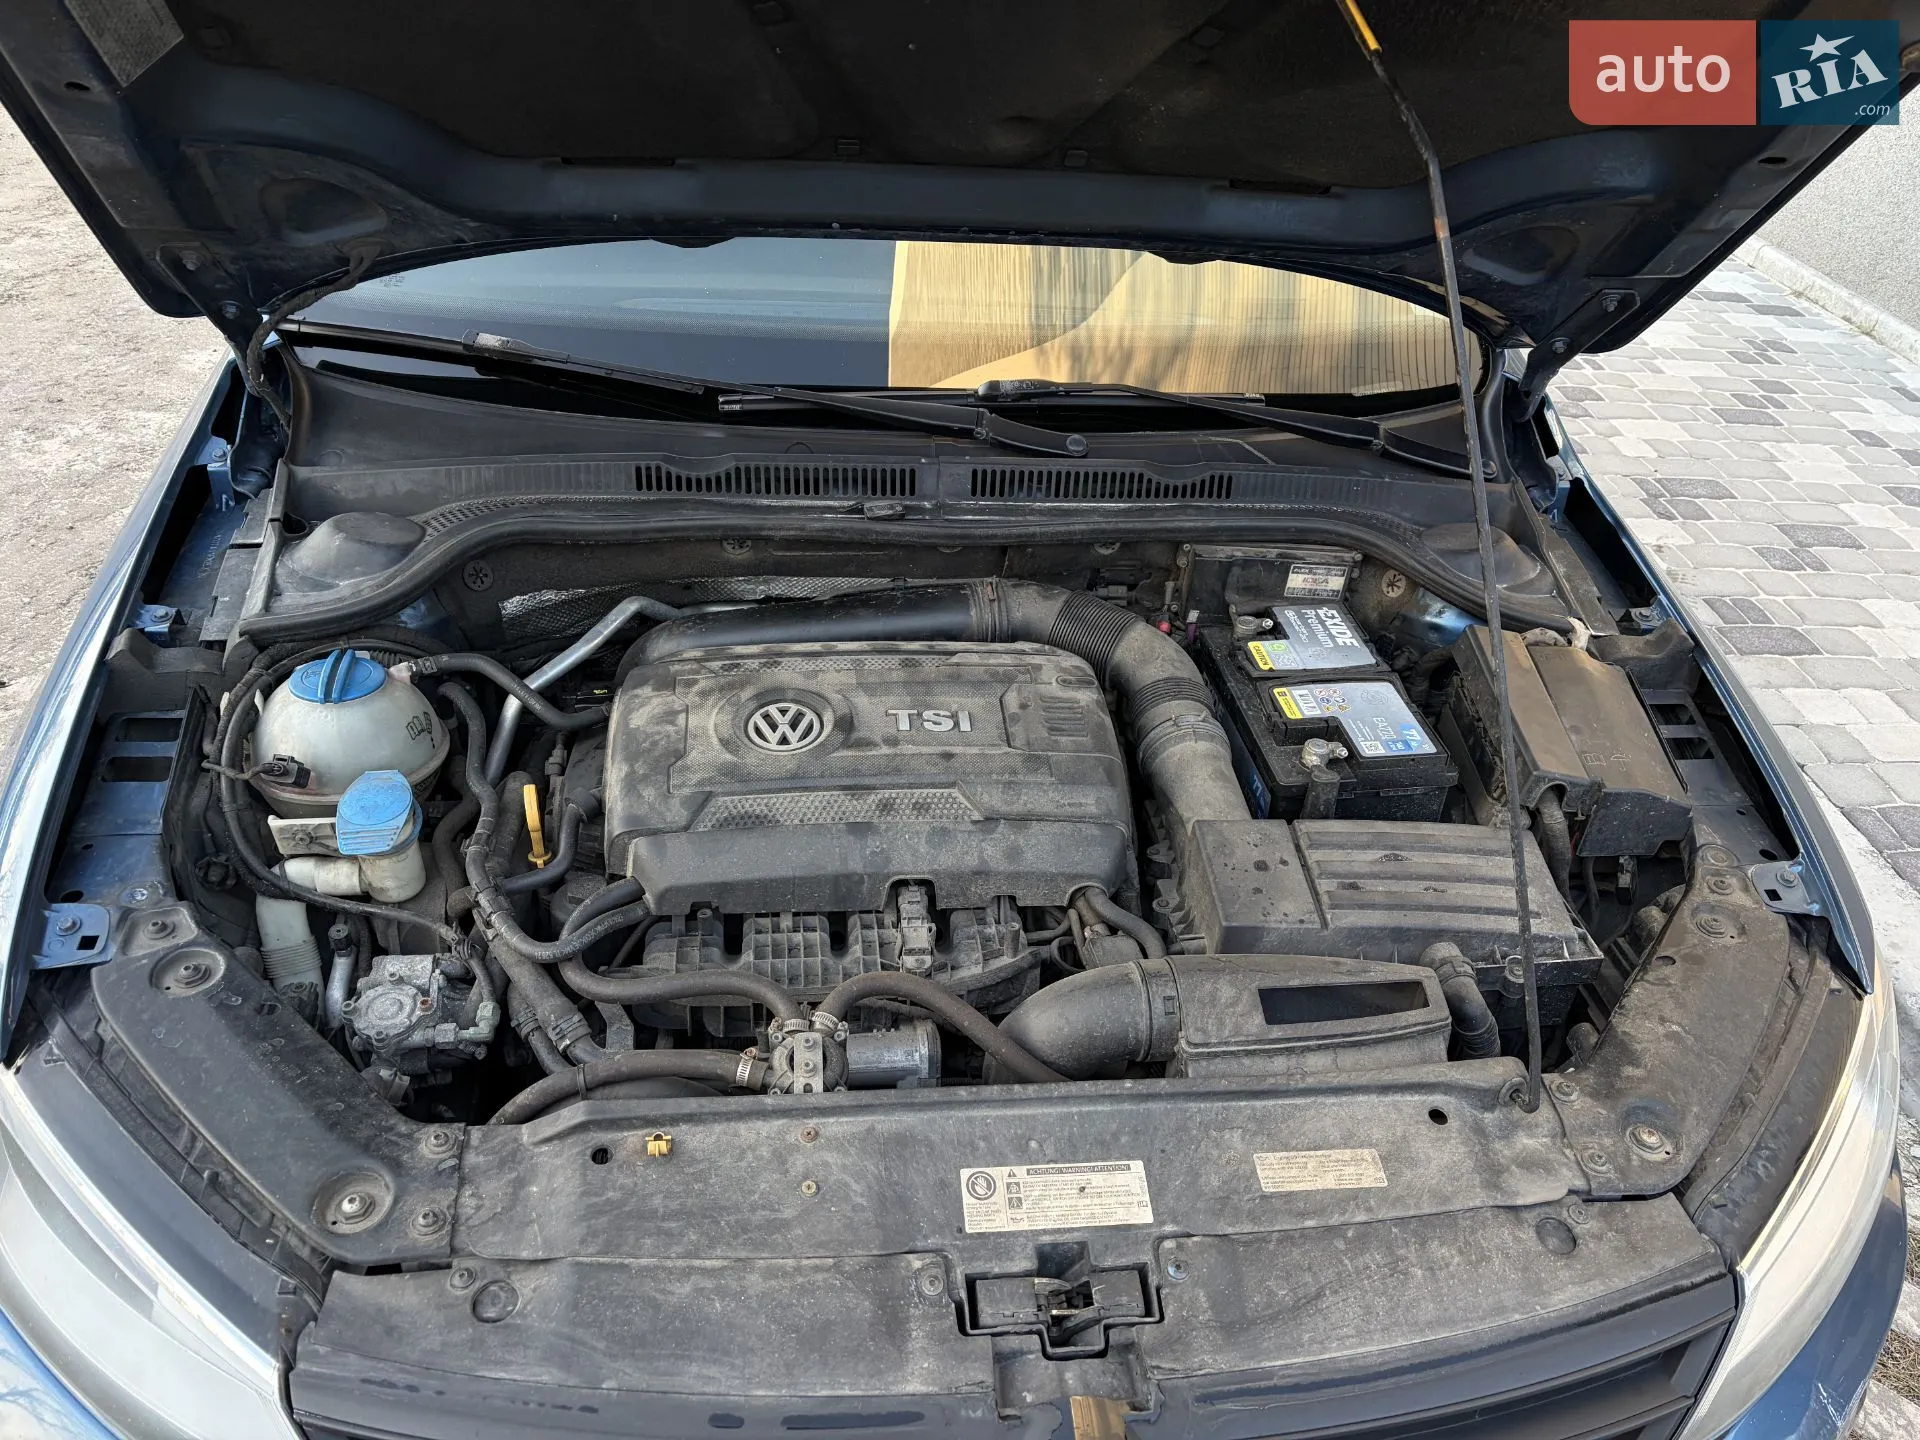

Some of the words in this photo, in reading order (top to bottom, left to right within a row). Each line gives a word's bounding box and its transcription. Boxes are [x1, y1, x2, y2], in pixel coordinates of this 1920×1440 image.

[1301, 609, 1335, 648] Premium
[1316, 606, 1360, 648] EXIDE
[1253, 645, 1270, 666] CAUTION
[887, 709, 972, 732] TSI
[1402, 728, 1421, 740] 77
[1029, 1167, 1060, 1175] ACHTUNG!
[1061, 1166, 1093, 1174] WARNING!
[1094, 1164, 1129, 1172] ATTENTION!
